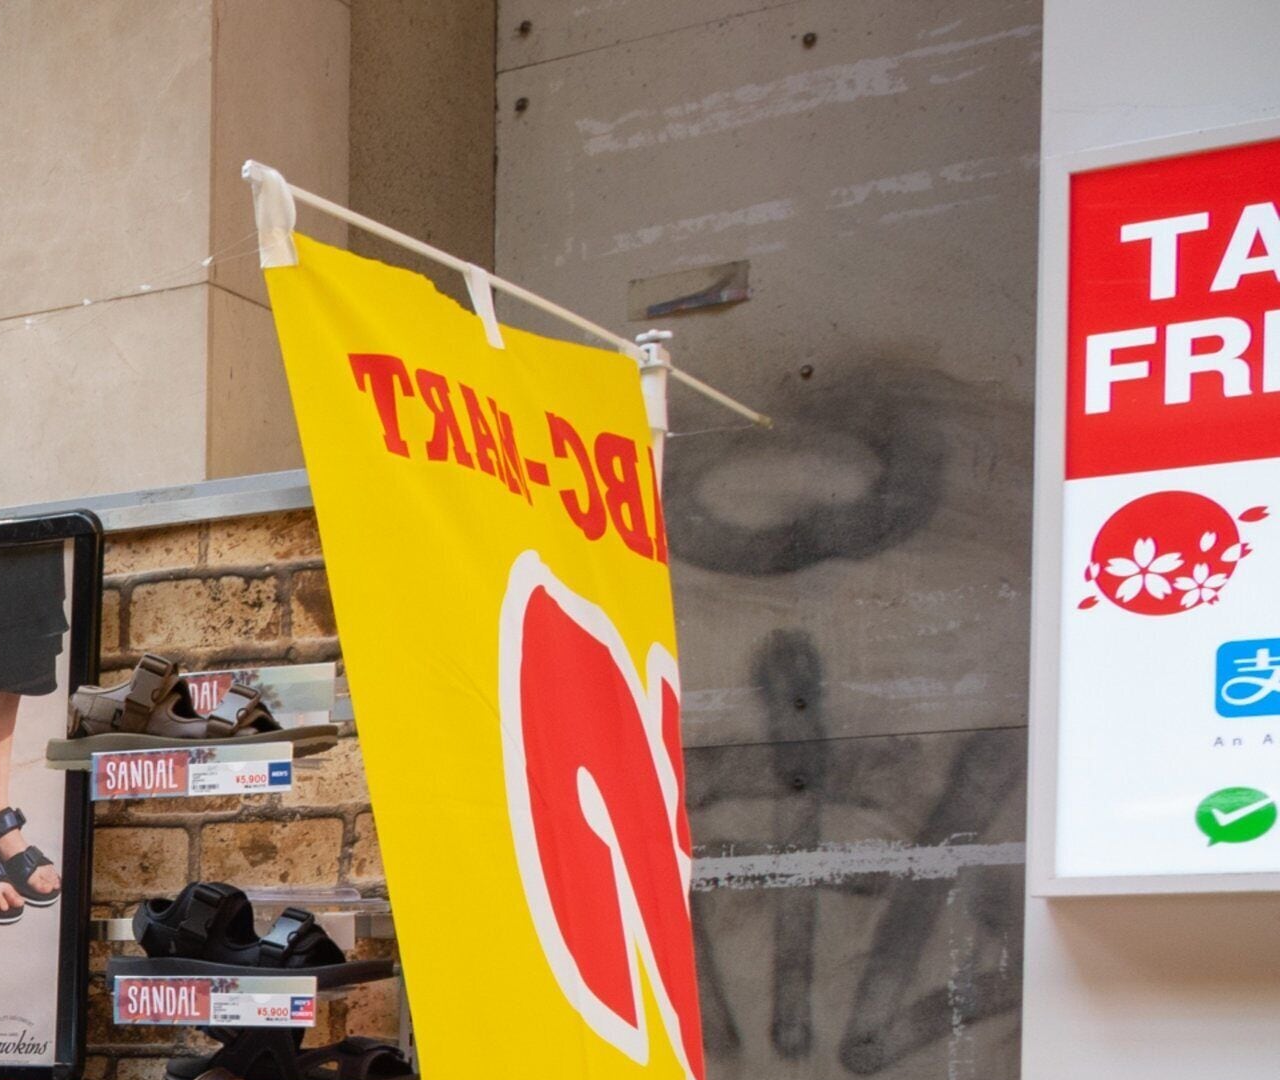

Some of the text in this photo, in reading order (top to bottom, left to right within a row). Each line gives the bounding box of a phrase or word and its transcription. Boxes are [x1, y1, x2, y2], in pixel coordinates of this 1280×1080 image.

[1084, 313, 1280, 415] FR
[106, 758, 268, 792] SANDAL ¥5,900
[127, 984, 289, 1017] SANDAL ¥5,900
